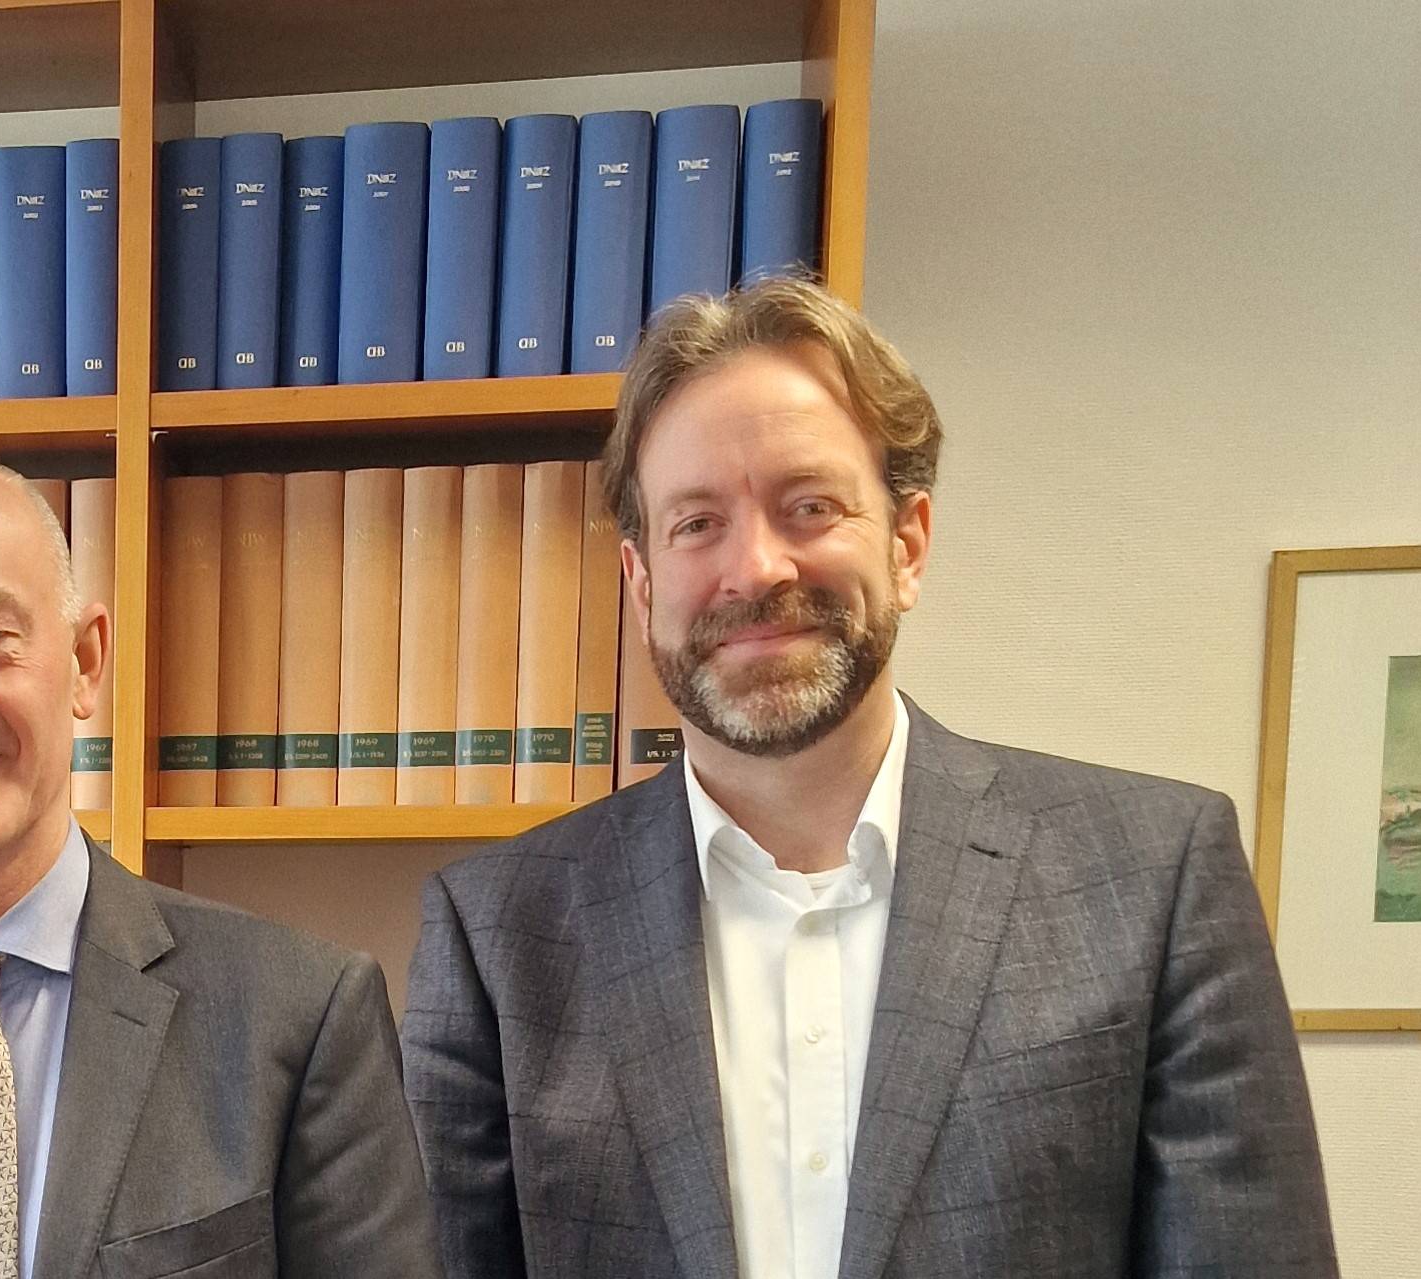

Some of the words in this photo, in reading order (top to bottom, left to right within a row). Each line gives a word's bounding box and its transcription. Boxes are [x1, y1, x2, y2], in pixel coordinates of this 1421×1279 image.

[354, 737, 378, 746] 1969
[413, 736, 436, 745] 1969
[473, 734, 496, 743] 1970
[532, 733, 555, 743] 1970
[235, 739, 257, 749] 1968
[297, 739, 320, 748] 1968
